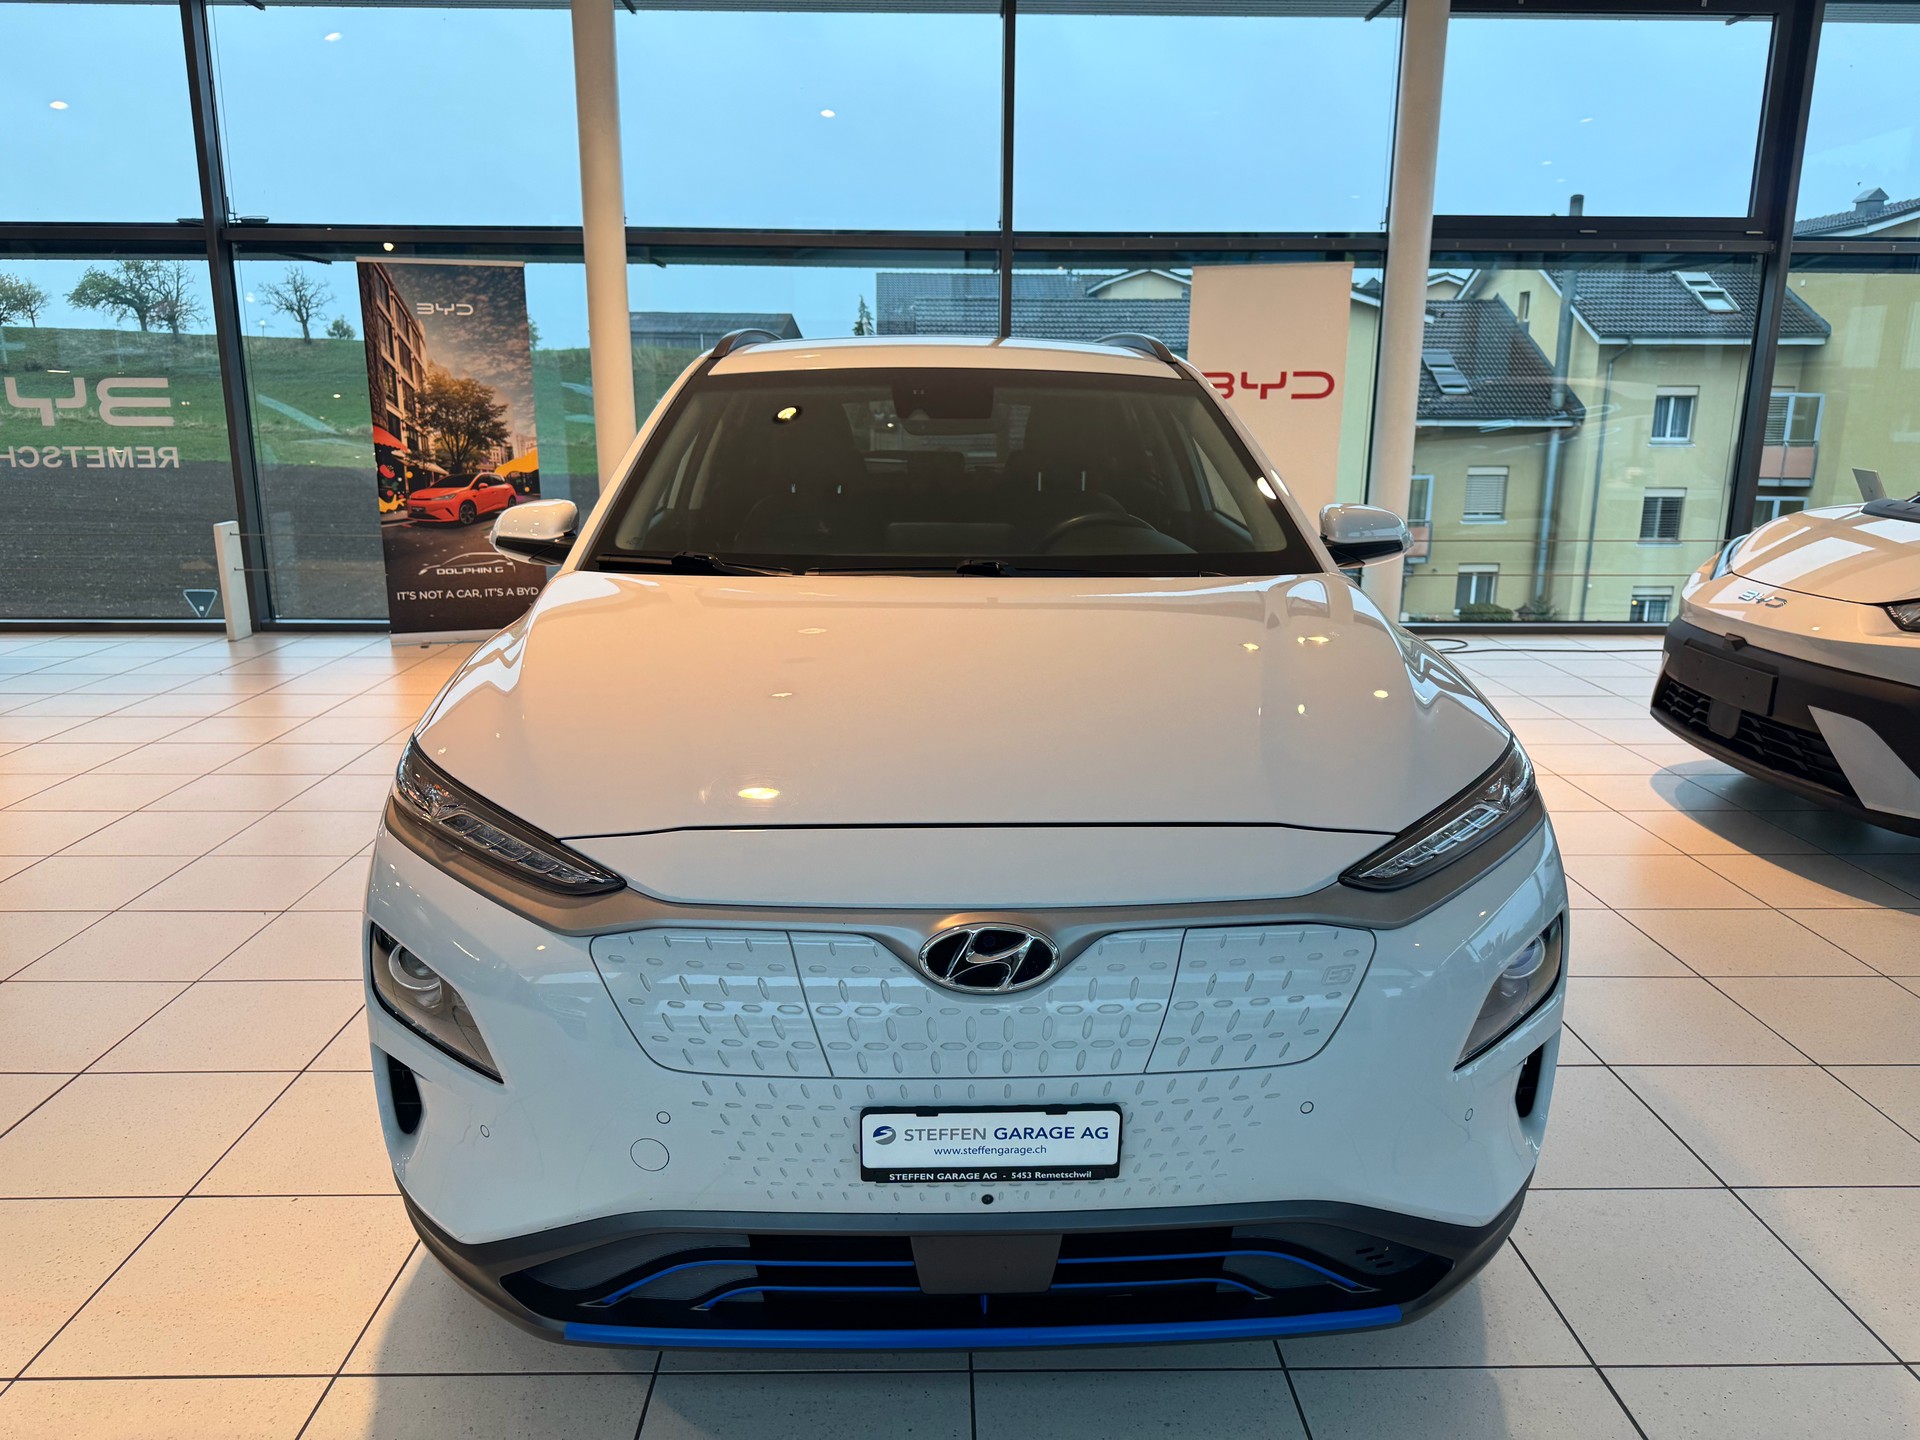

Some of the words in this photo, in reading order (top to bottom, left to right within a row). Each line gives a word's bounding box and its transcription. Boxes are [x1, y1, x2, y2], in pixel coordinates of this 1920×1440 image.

[416, 302, 474, 316] BYD
[1201, 371, 1335, 400] BYD
[436, 566, 492, 575] DOLPHIN
[396, 591, 417, 601] IT'S
[419, 590, 443, 600] NOT
[445, 590, 455, 599] A
[456, 589, 482, 599] CAR,
[485, 588, 504, 597] IT'S
[506, 587, 515, 597] A
[516, 586, 539, 596] BYD
[1738, 590, 1788, 609] BYD
[904, 1128, 987, 1142] STEFFEN
[993, 1126, 1075, 1140] GARAGE
[1080, 1126, 1109, 1140] AG
[933, 1145, 1047, 1157] www.steffengarage.ch
[889, 1173, 934, 1181] STEFFEN
[936, 1172, 980, 1180] GARAGE
[982, 1172, 998, 1180] AG
[1011, 1171, 1032, 1179] 5453
[1034, 1170, 1092, 1179] Remetschwil
